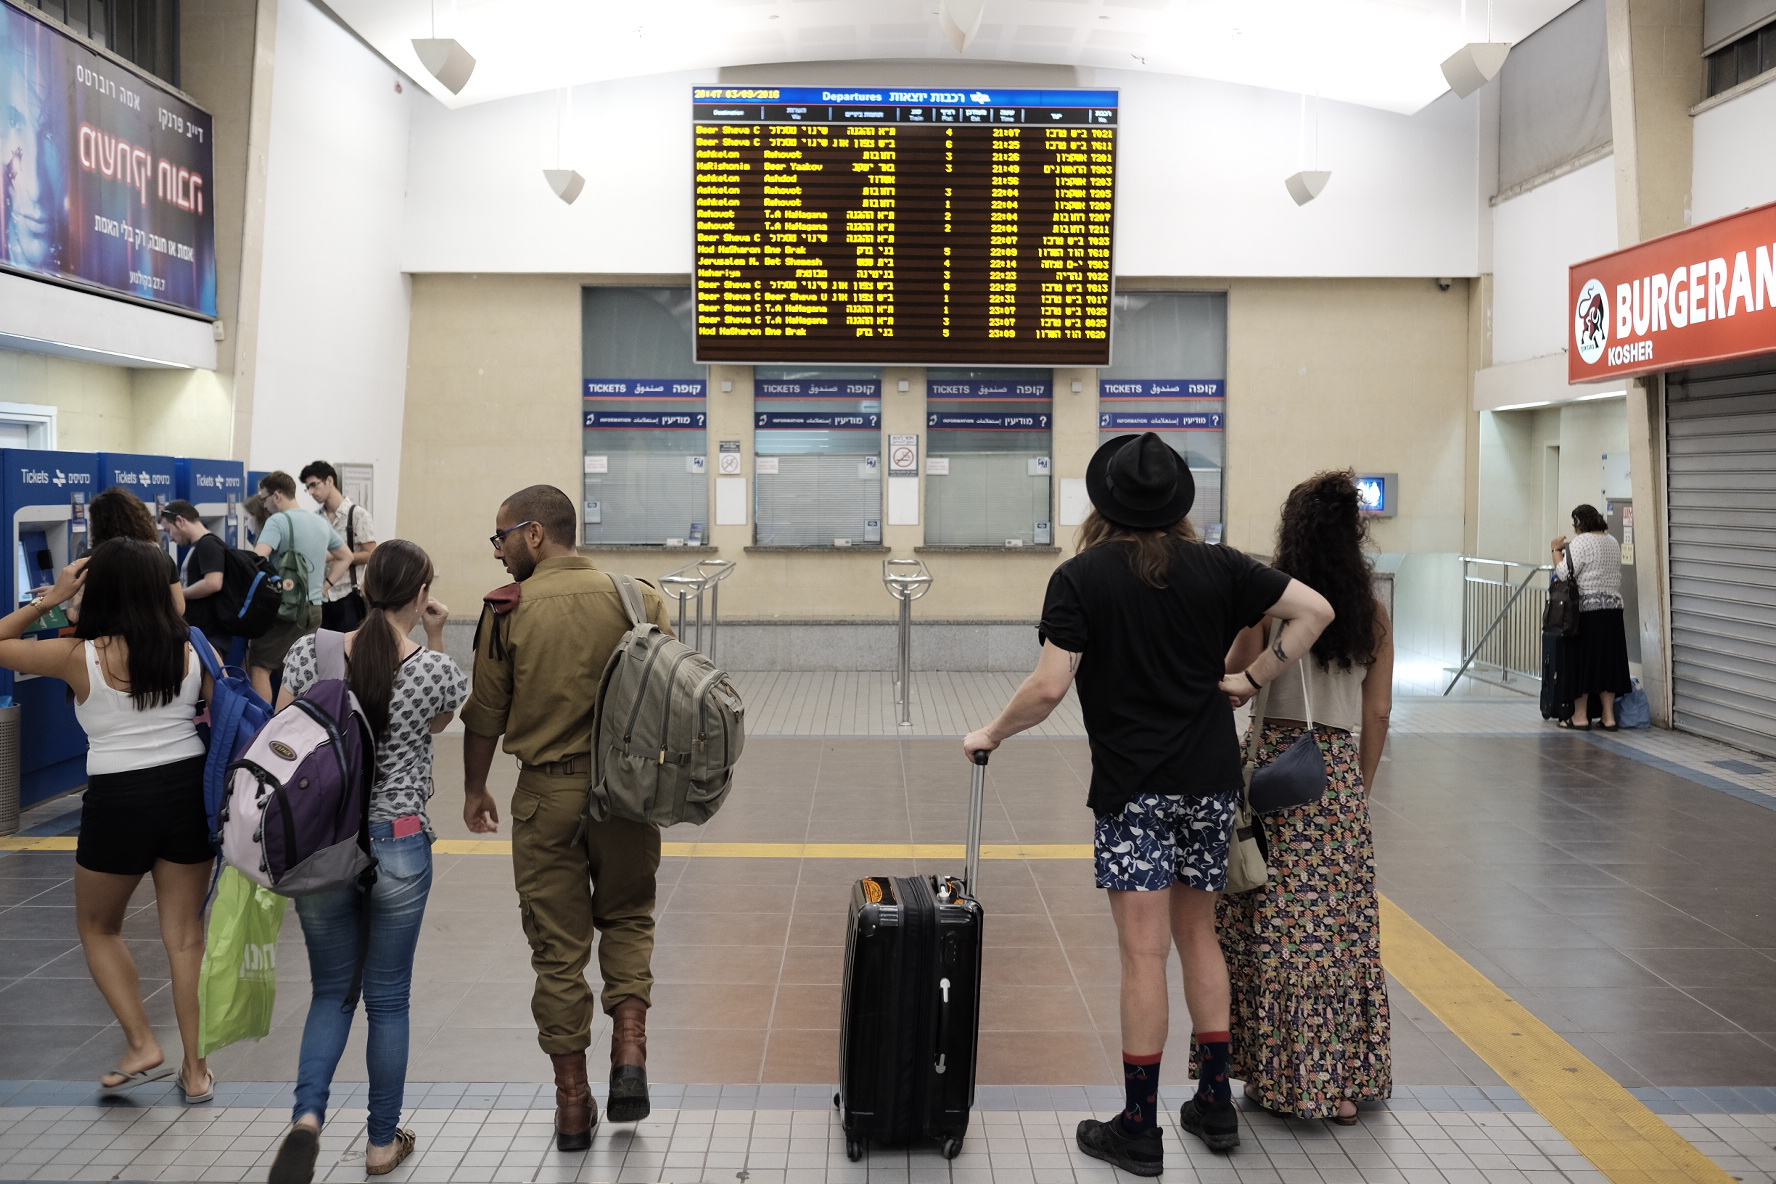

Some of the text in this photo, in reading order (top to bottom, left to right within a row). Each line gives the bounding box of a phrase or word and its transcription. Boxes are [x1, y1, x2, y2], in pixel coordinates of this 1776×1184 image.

[76, 65, 140, 111] אמה רוברטס
[694, 90, 722, 98] 20:47
[823, 91, 882, 102] Departures
[889, 92, 965, 103] רכבות יוצאות
[158, 106, 203, 143] דייב פרנקו
[696, 126, 760, 134] Beer Sheva C
[946, 128, 952, 136] 4
[993, 129, 1020, 137] 21:07
[696, 138, 760, 146] Beer Sheva C
[946, 140, 952, 149] 6
[993, 141, 1020, 149] 21:25
[946, 152, 952, 161] 3
[992, 153, 1020, 161] 21:26
[696, 162, 750, 170] HaRishonim
[946, 164, 952, 172] 3
[992, 165, 1019, 173] 21:49
[992, 177, 1019, 185] 21:56
[945, 188, 952, 196] 3
[992, 189, 1018, 197] 22:04
[946, 200, 950, 208] 1
[991, 201, 1018, 209] 22:04
[697, 210, 734, 218] Rehovot
[945, 212, 951, 220] 2
[991, 212, 1018, 221] 22:04
[697, 222, 734, 230] Rehovot
[945, 224, 951, 232] 2
[991, 224, 1018, 233] 22:04
[94, 215, 194, 262] אמת או חובה, רק בלי האמת
[723, 234, 750, 242] Sheva
[754, 234, 760, 242] C
[991, 236, 1018, 244] 22:07
[944, 248, 950, 256] 5
[990, 248, 1017, 256] 22:09
[749, 258, 759, 266] M.
[944, 259, 950, 268] 4
[990, 260, 1016, 268] 22:14
[944, 271, 950, 279] 3
[990, 272, 1016, 280] 22:23
[129, 270, 152, 290] בקולנוע
[754, 281, 761, 289] C
[944, 283, 950, 291] 6
[990, 283, 1016, 291] 22:25
[1617, 242, 1776, 339] BURGERAN
[754, 293, 761, 301] C
[944, 294, 949, 302] 1
[990, 295, 1015, 303] 22:31
[699, 304, 720, 312] Beer
[724, 304, 751, 312] Sheva
[944, 306, 948, 314] 1
[989, 306, 1016, 315] 23:07
[699, 316, 761, 324] Beer Sheva C
[943, 318, 949, 326] 3
[989, 318, 1015, 326] 23:07
[943, 329, 949, 337] 5
[989, 330, 1015, 338] 23:09
[1608, 340, 1653, 366] KOSHER
[588, 384, 626, 393] TICKETS
[634, 383, 664, 394] صندوق
[672, 385, 701, 395] קופה
[763, 385, 800, 393] TICKETS
[809, 384, 838, 394] صندوق
[847, 385, 875, 395] קופה
[933, 386, 970, 394] TICKETS
[978, 385, 1007, 395] صندوق
[1016, 386, 1045, 396] קופה
[1105, 384, 1142, 393] TICKETS
[1150, 384, 1180, 394] صندوق
[1189, 384, 1216, 395] קופה
[662, 416, 690, 425] מודיעין
[835, 417, 863, 426] מודיעין
[1005, 417, 1033, 426] מודיעין
[1183, 417, 1206, 426] מודיעין
[21, 469, 49, 484] Tickets
[114, 470, 136, 484] Tickets
[196, 474, 214, 487] Tickets
